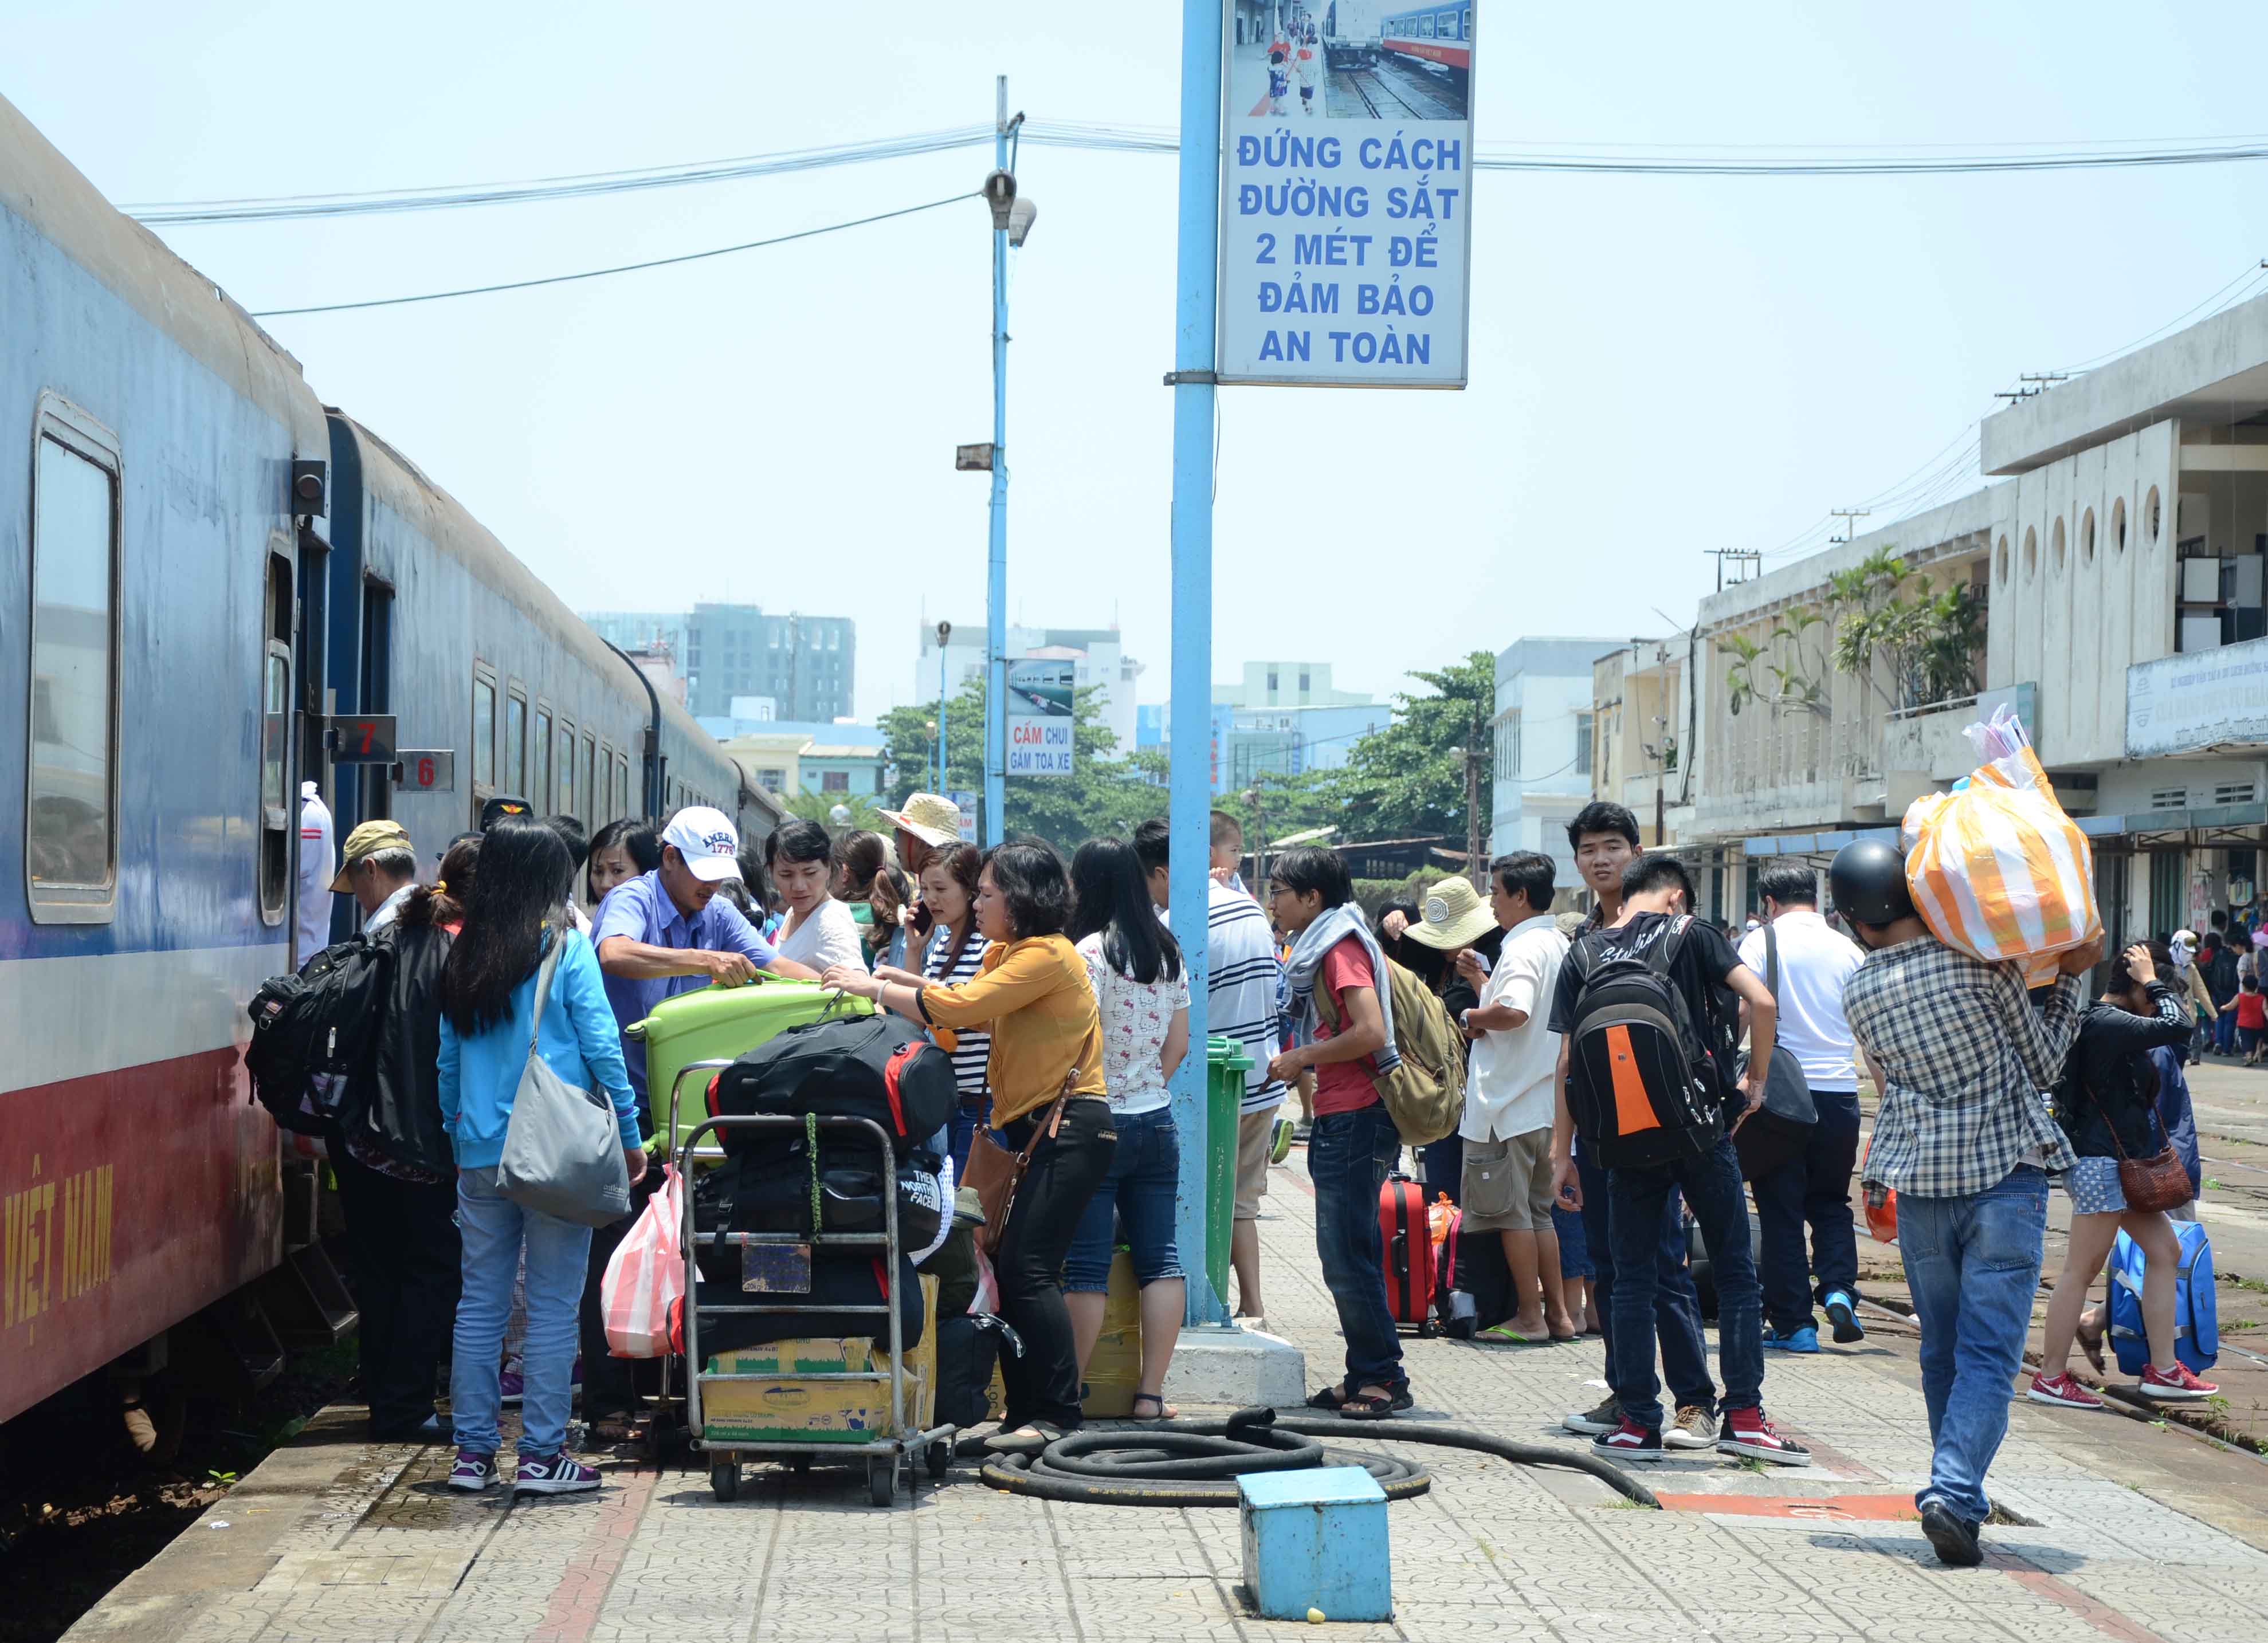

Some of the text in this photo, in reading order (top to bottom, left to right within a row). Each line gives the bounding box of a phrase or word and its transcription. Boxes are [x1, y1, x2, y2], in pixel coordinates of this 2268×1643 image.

[1237, 128, 1461, 171] ĐỨNG CÁCH
[1238, 174, 1459, 220] ĐƯỜNG SẮT
[1255, 222, 1438, 268] 2 MÉT ĐỂ
[1257, 270, 1434, 317] ĐẢM BẢO
[1258, 324, 1430, 365] AN TOÀN
[358, 723, 376, 754] 7
[1014, 720, 1068, 745] CẤM CHUI
[418, 757, 435, 787] 6
[1035, 752, 1053, 770] TOA
[1057, 752, 1070, 770] XE
[900, 1181, 932, 1196] NORTH
[913, 1170, 931, 1182] THE
[910, 1191, 932, 1209] FACE
[61, 1164, 113, 1303] NAM
